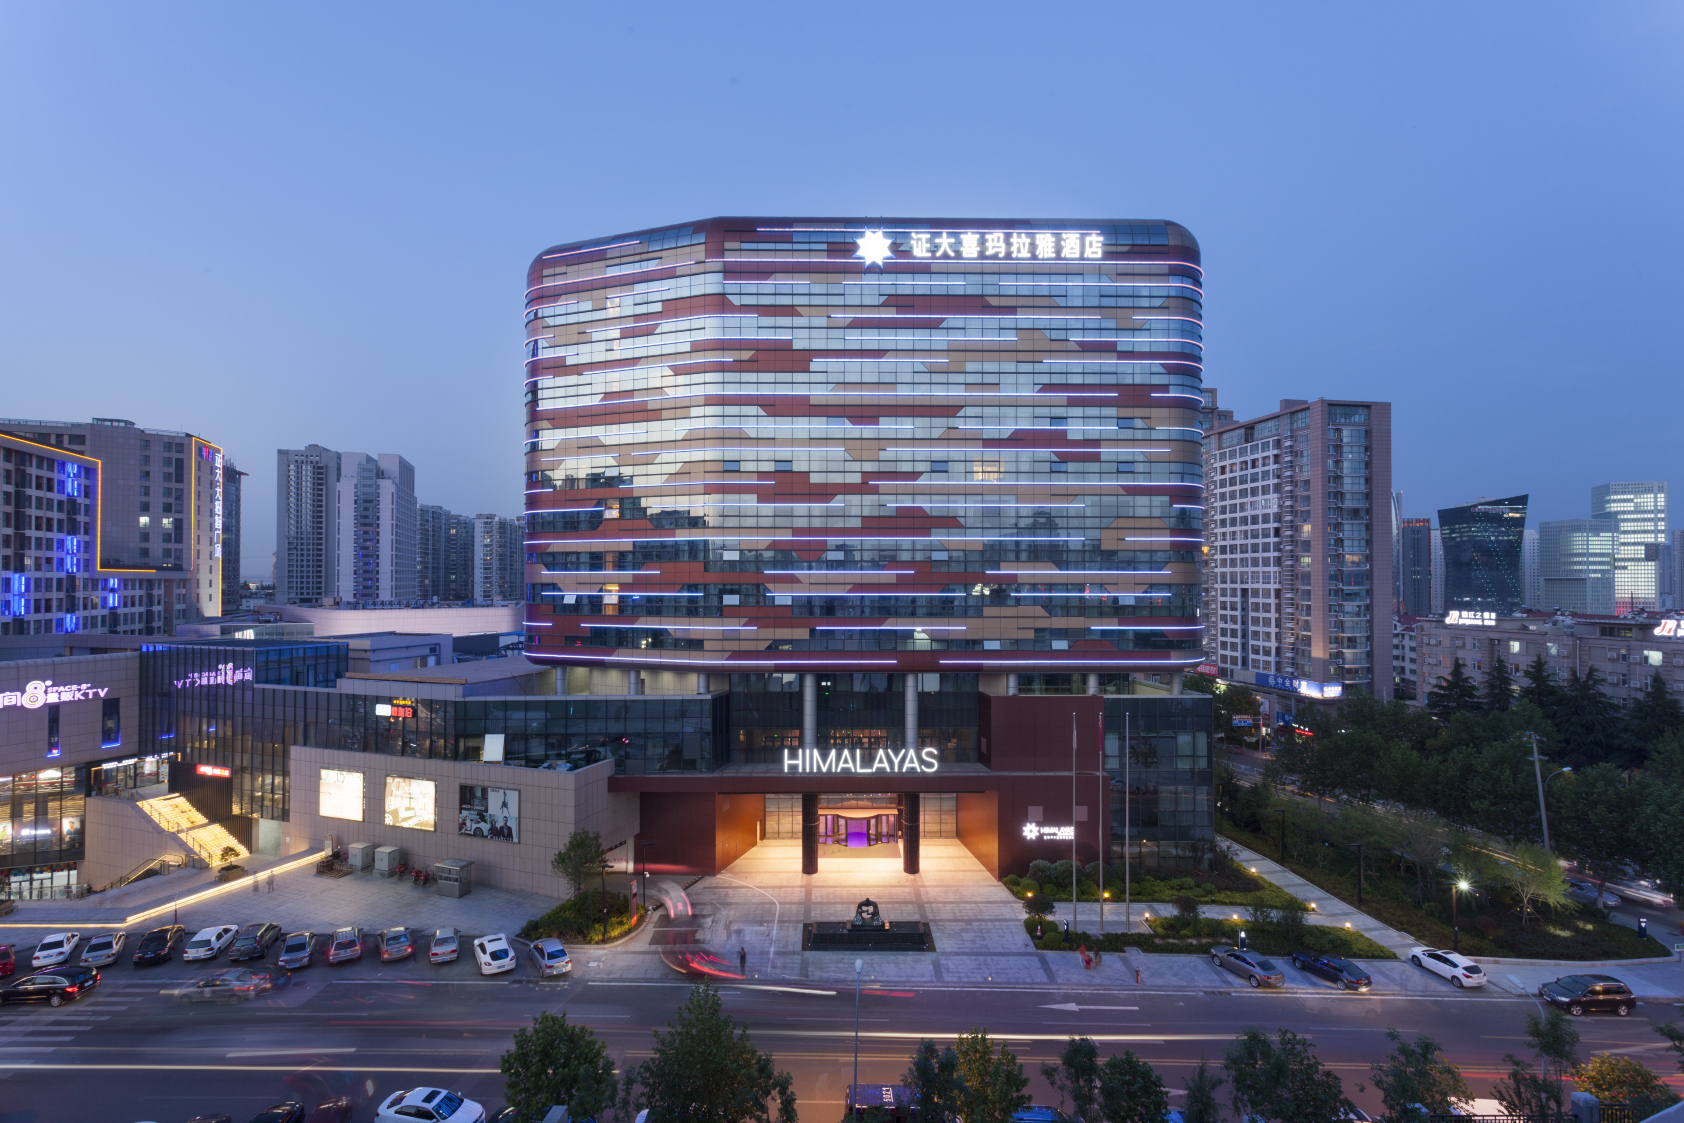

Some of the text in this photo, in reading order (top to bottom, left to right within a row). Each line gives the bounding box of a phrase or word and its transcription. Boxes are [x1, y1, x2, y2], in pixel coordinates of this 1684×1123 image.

[910, 232, 1103, 258] 证大喜玛拉雅酒店
[783, 747, 938, 773] HIMALAYAS
